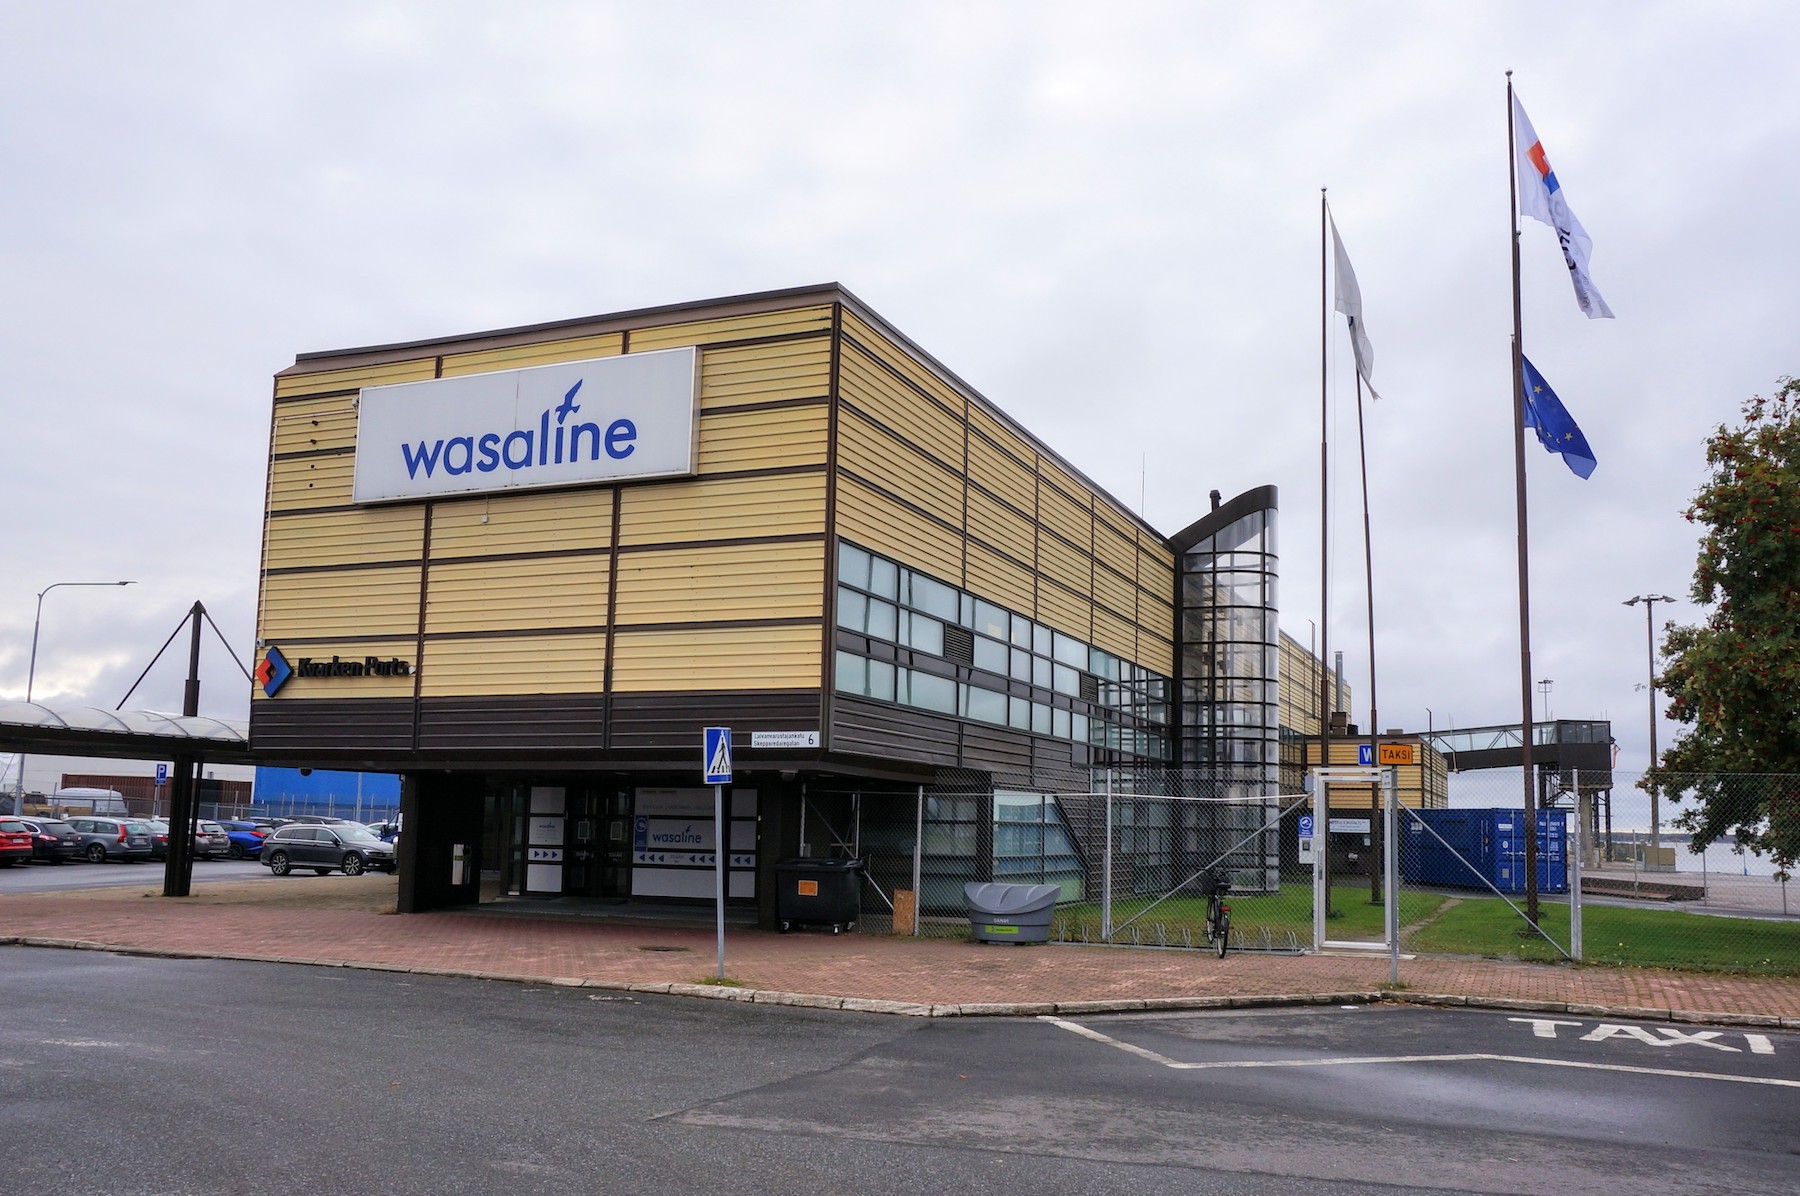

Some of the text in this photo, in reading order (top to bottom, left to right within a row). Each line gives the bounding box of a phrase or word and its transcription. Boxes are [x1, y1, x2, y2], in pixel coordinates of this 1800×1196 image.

[401, 379, 637, 480] wasaline
[298, 656, 409, 677] Kvarken Ports
[808, 733, 814, 745] 6
[1382, 749, 1410, 760] TAKSI
[157, 765, 166, 778] P
[652, 825, 702, 844] wasaline
[1507, 1017, 1776, 1055] TAXI
